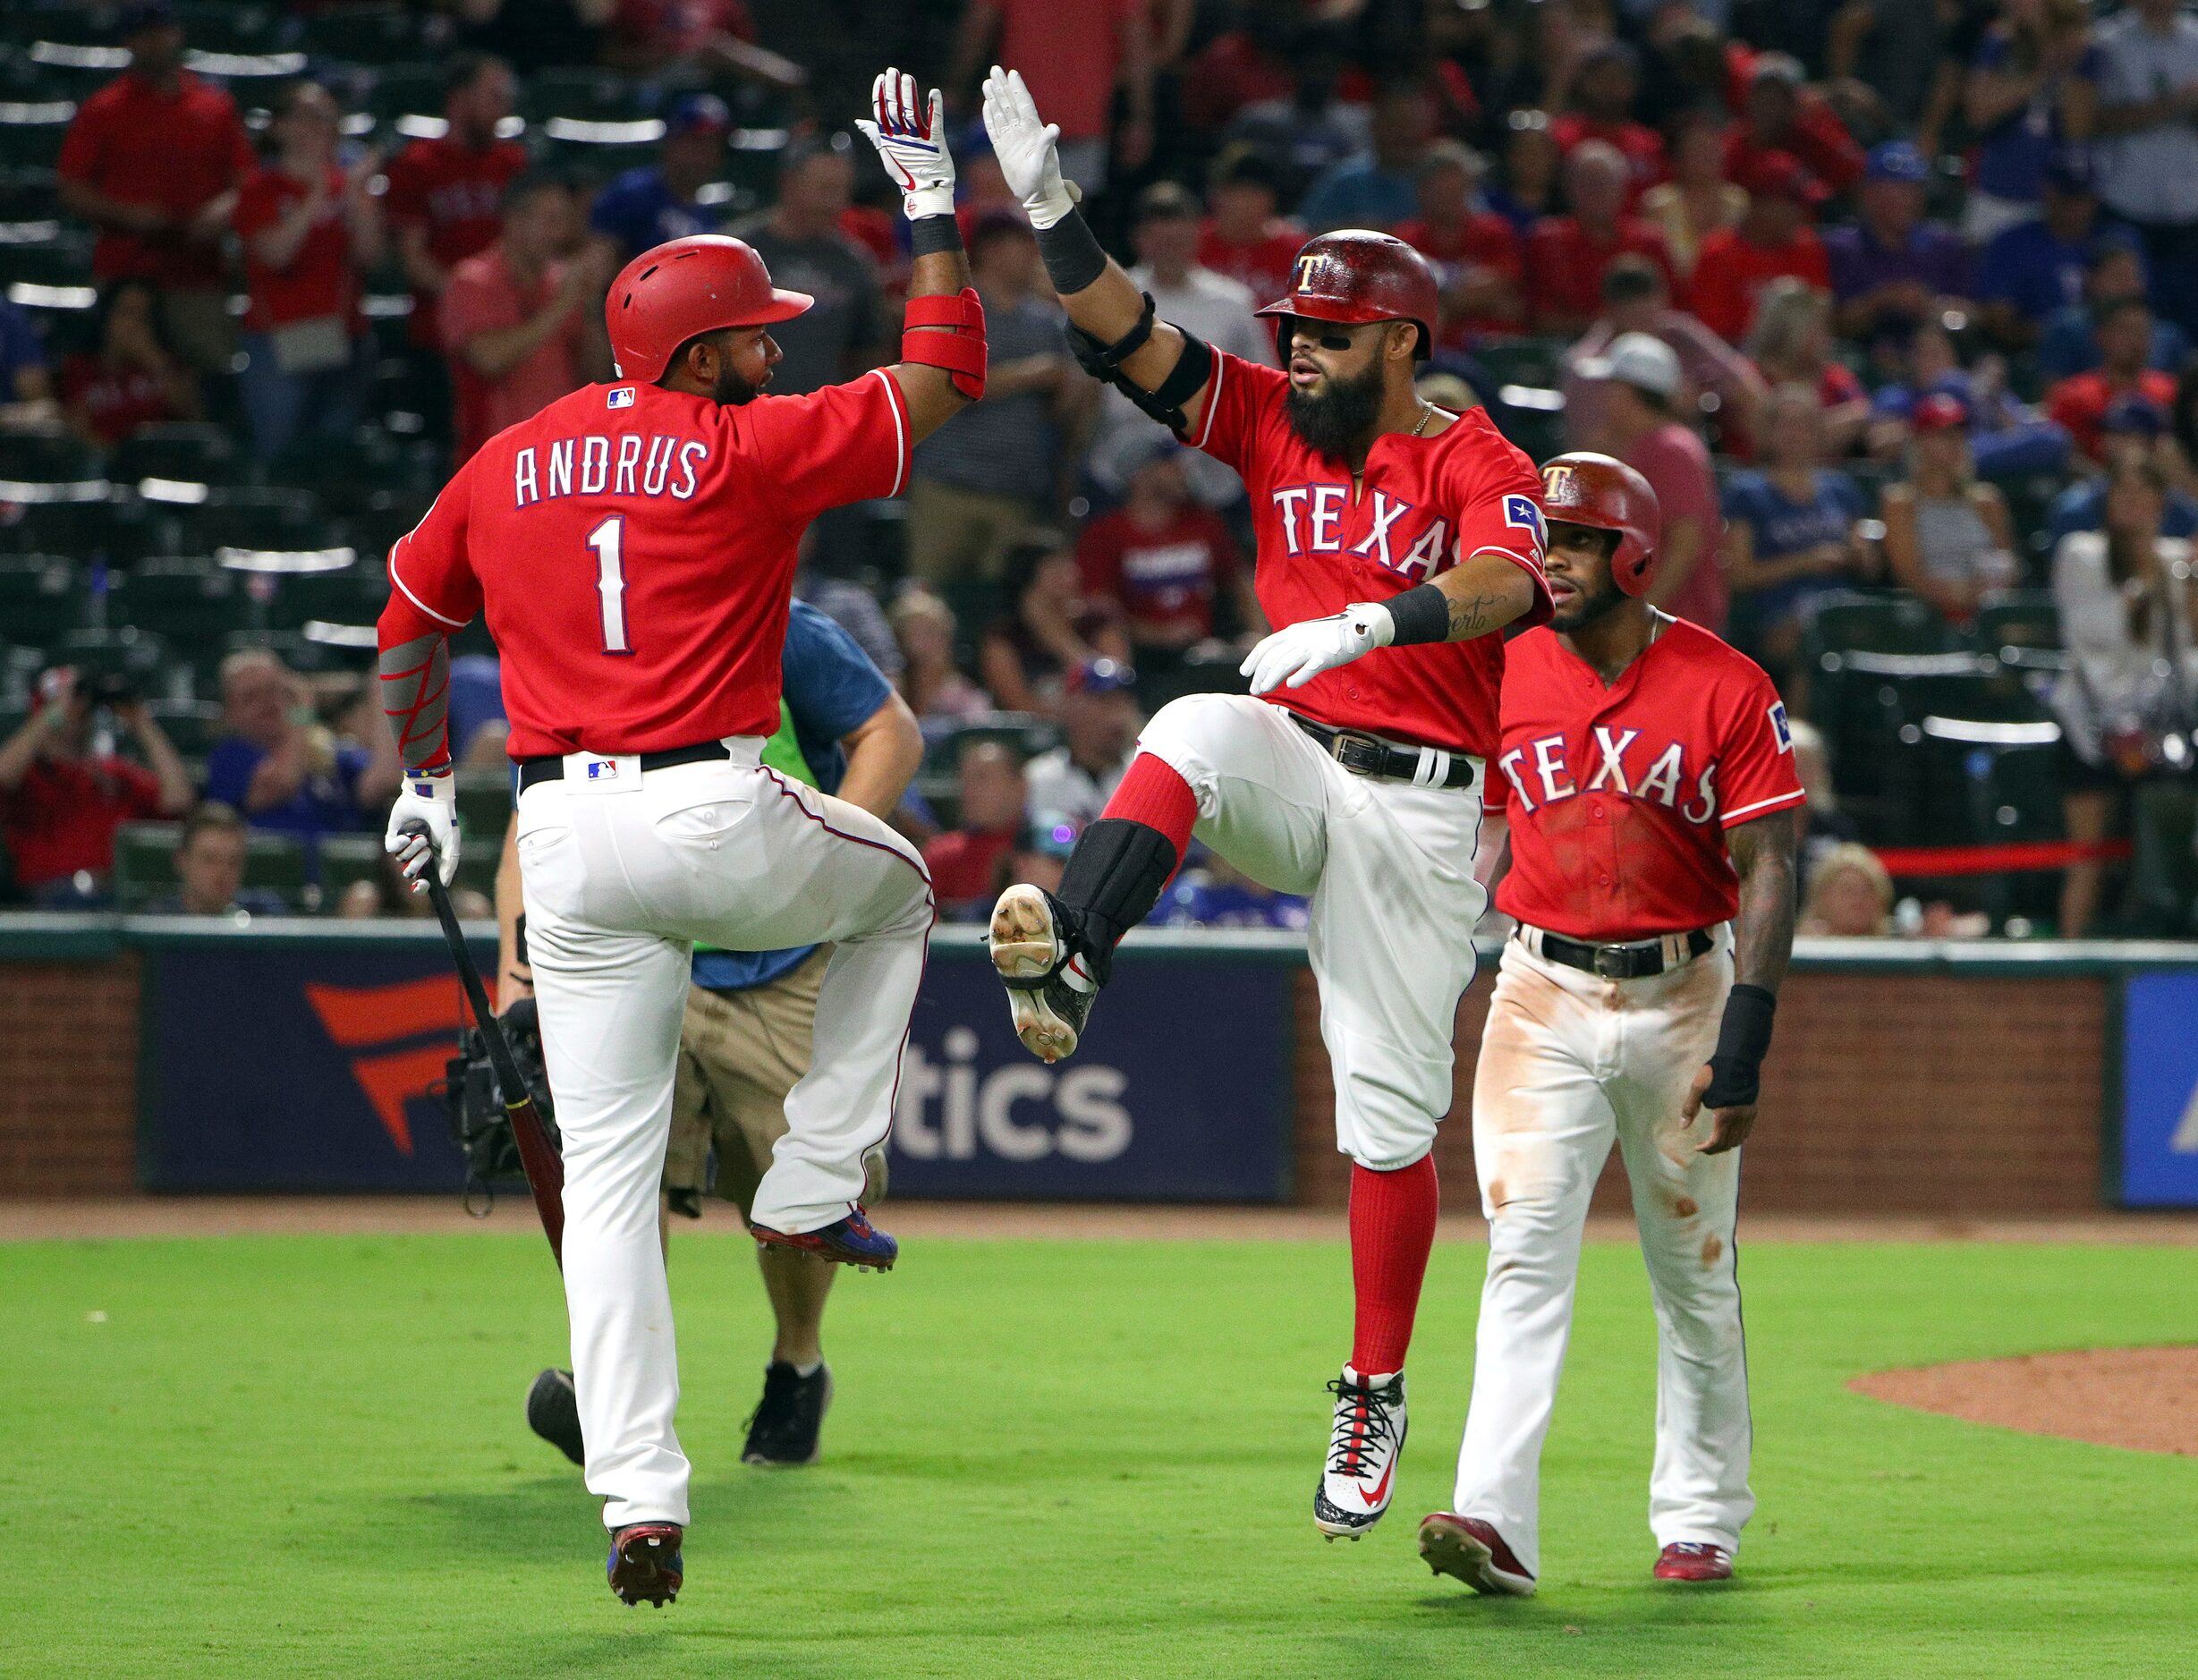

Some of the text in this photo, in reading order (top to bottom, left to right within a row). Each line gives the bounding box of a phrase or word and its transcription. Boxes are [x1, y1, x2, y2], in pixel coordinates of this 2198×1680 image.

[1297, 255, 1328, 295] T
[515, 433, 709, 511] ANDRUS
[1542, 466, 1574, 502] T
[1272, 482, 1462, 583] TEXA
[585, 514, 635, 655] 1
[1498, 723, 1718, 825] TEXAS
